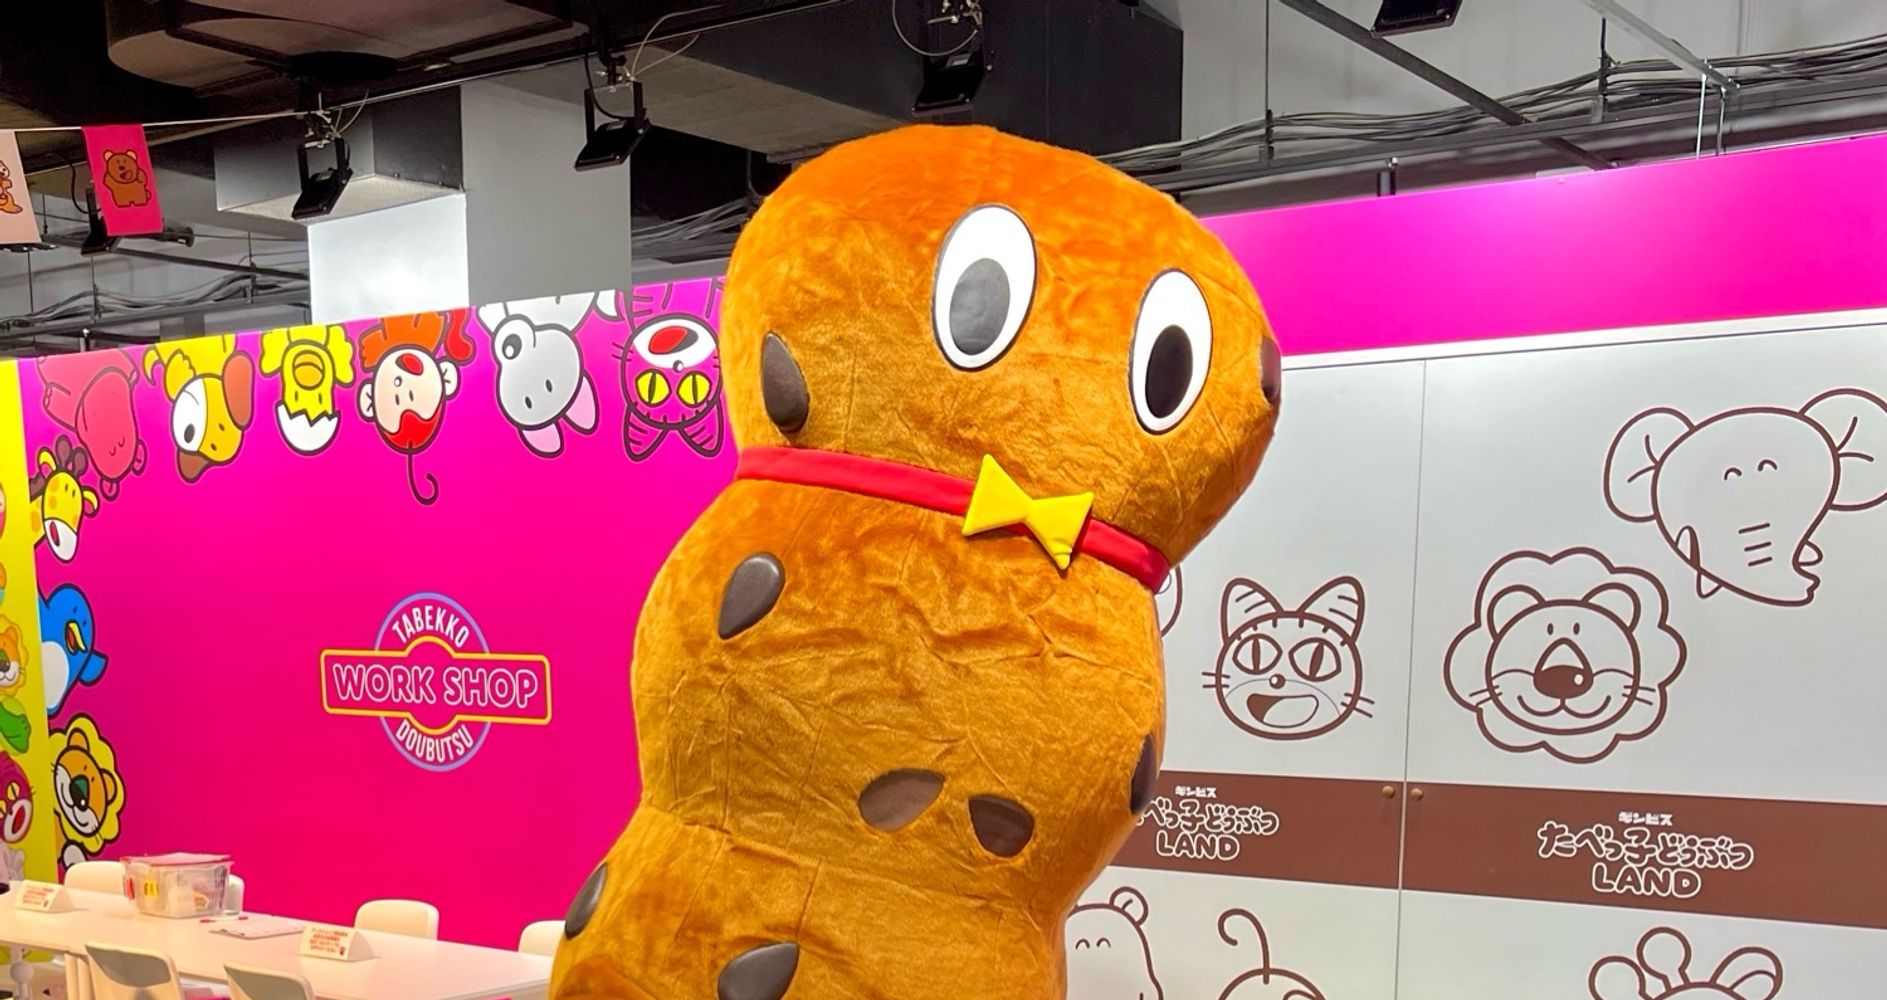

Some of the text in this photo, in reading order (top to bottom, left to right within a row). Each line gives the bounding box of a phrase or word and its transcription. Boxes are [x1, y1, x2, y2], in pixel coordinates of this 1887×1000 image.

[392, 605, 470, 648] TABEKKO
[333, 663, 538, 709] WORK SHOP
[396, 719, 474, 763] DOUBUTSU
[1137, 796, 1280, 836] べっ子どうぶつ
[1618, 811, 1673, 826] ギンビス
[1156, 830, 1240, 861] LAND
[1537, 821, 1755, 870] たべっ子どうぶつ
[1592, 862, 1701, 898] LAND
